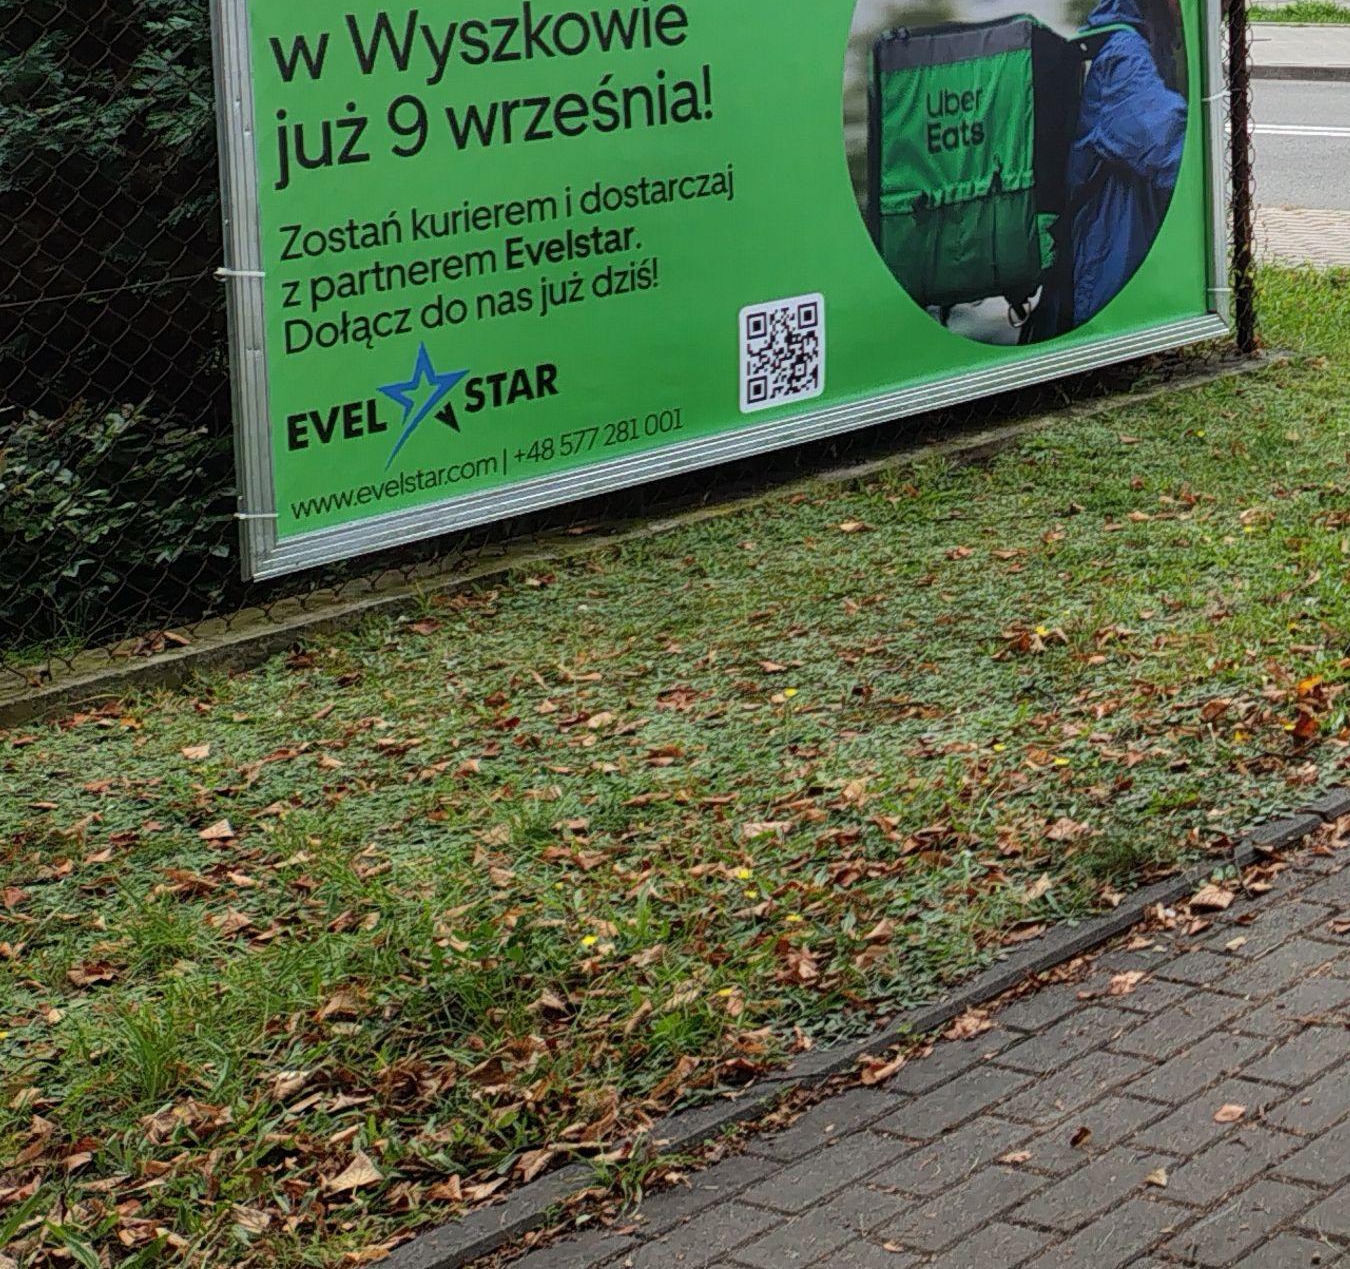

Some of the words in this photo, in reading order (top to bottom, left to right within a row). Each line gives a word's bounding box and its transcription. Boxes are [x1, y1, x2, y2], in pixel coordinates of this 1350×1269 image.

[269, 32, 330, 83] w
[925, 84, 984, 117] Uber
[272, 101, 370, 191] już
[386, 94, 430, 158] 9
[445, 64, 714, 152] września!
[926, 119, 986, 156] Eats
[278, 212, 403, 261] Zostań
[410, 197, 558, 241] kurierem
[565, 185, 573, 218] i
[580, 163, 736, 214] dostarczaj
[281, 279, 301, 309] z
[309, 245, 498, 313] partnerem
[505, 223, 643, 272] Evelstar.
[283, 309, 412, 356] Dołącz
[420, 296, 469, 330] do
[476, 283, 533, 318] nas
[539, 270, 584, 318] już
[591, 257, 660, 298] dziś!
[286, 397, 388, 452] EVEL
[462, 362, 560, 414] STAR
[290, 457, 498, 520] www.evelstar.com
[513, 440, 555, 466] +48
[559, 427, 602, 458] 577
[603, 419, 640, 448] 281
[643, 407, 685, 437] 001
